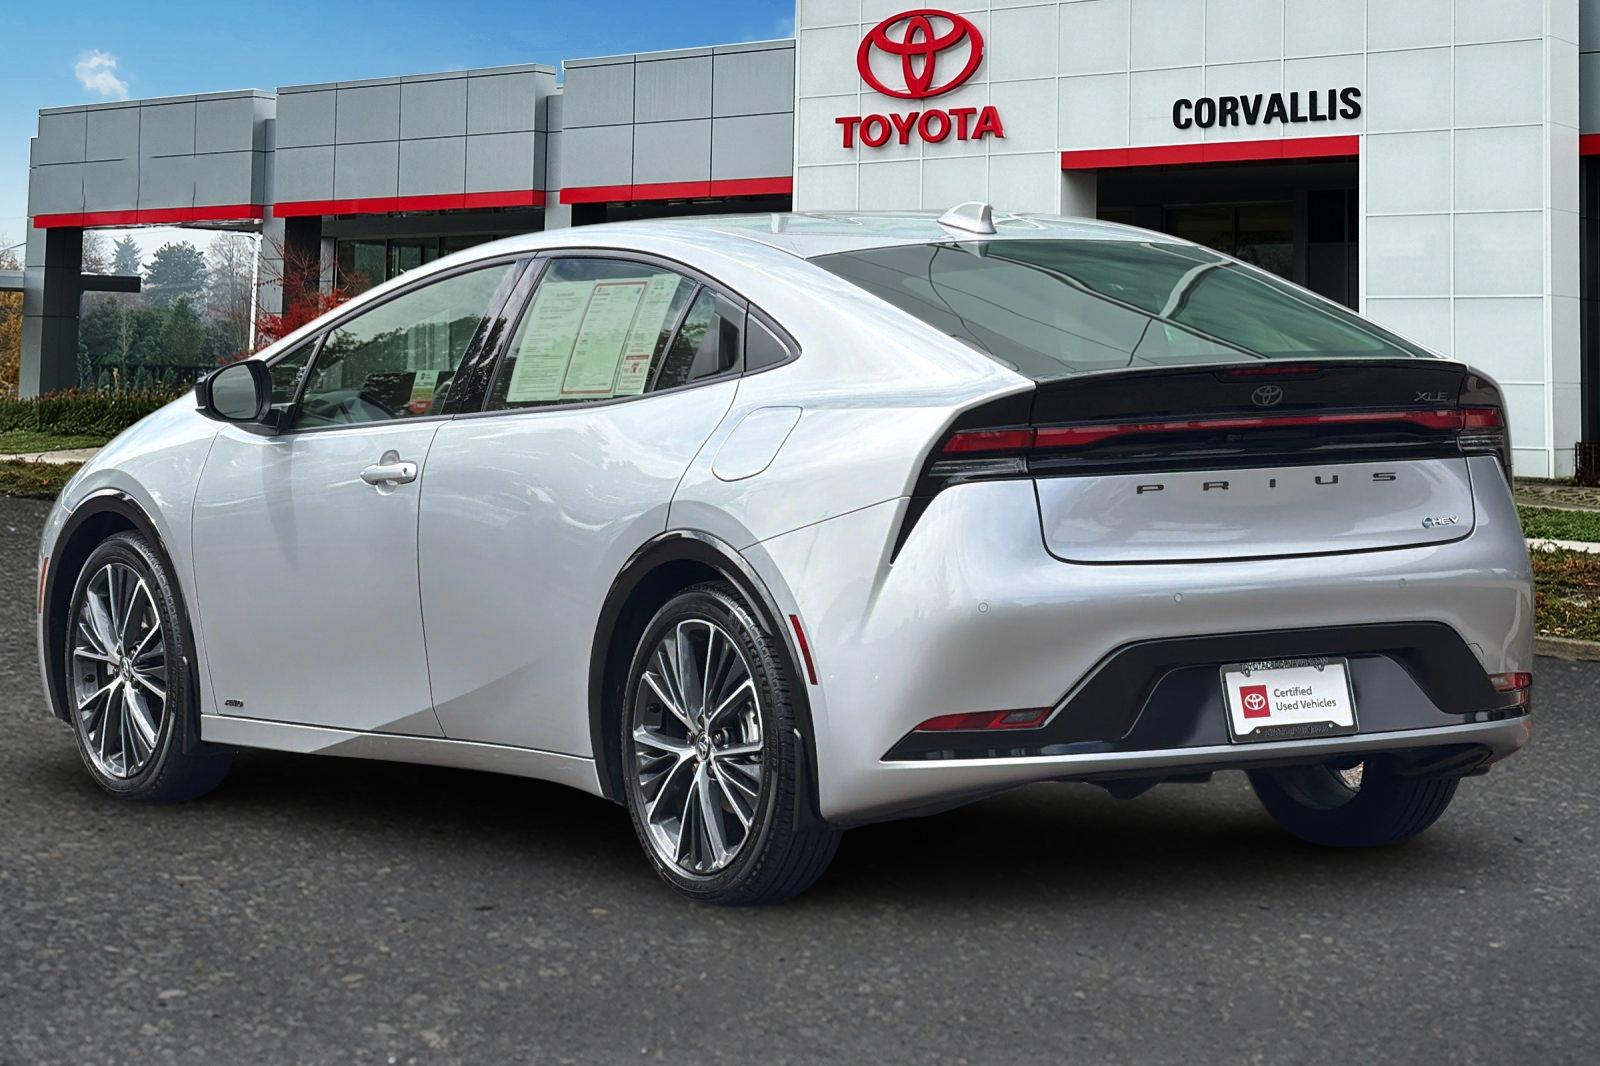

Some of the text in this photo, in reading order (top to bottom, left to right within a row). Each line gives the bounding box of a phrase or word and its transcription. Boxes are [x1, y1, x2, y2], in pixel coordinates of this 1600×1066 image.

[1172, 87, 1363, 130] CORVALLIS
[835, 105, 1006, 149] TOYOTA
[1414, 391, 1449, 402] XLE
[1136, 472, 1397, 494] PRIUS
[1273, 685, 1313, 698] Certified
[1275, 697, 1337, 711] Used Vehicles
